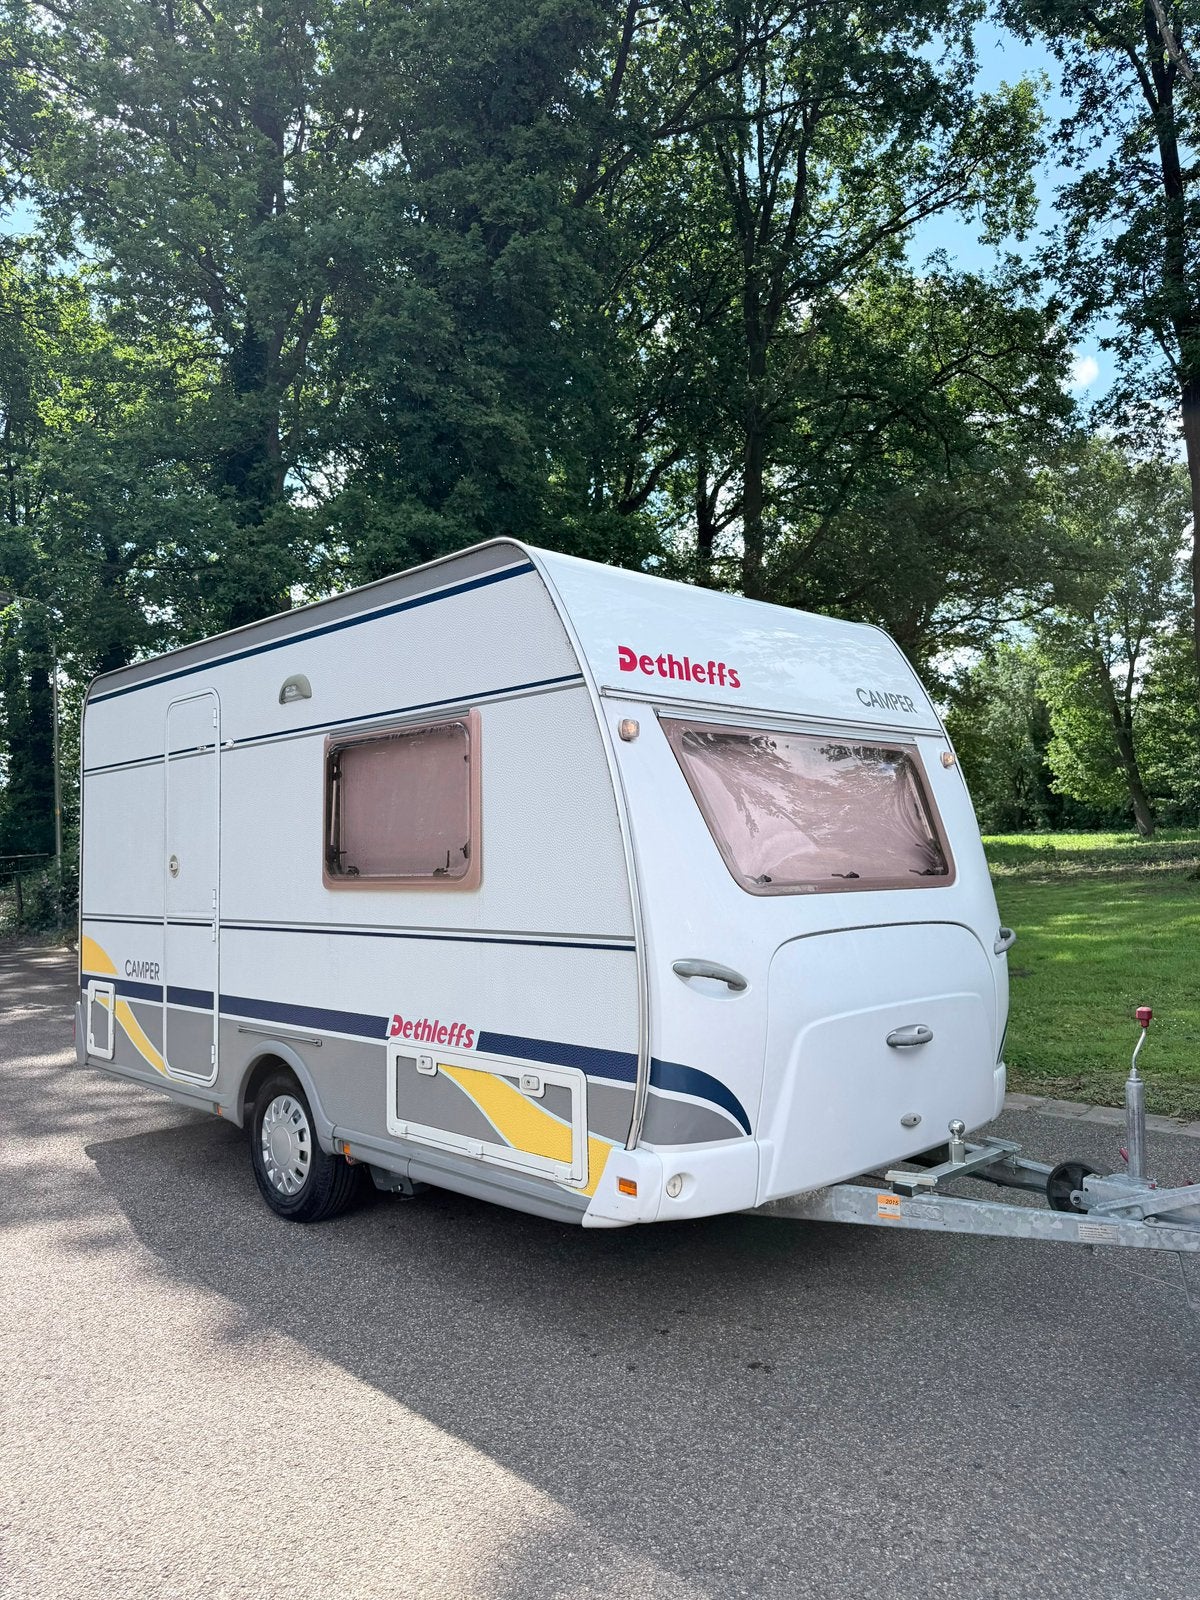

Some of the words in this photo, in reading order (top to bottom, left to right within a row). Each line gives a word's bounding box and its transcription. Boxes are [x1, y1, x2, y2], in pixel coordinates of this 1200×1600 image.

[618, 645, 741, 688] Dethleffs
[856, 687, 917, 713] CAMPER
[125, 959, 160, 981] CAMPER
[390, 1014, 474, 1049] Dethleffs
